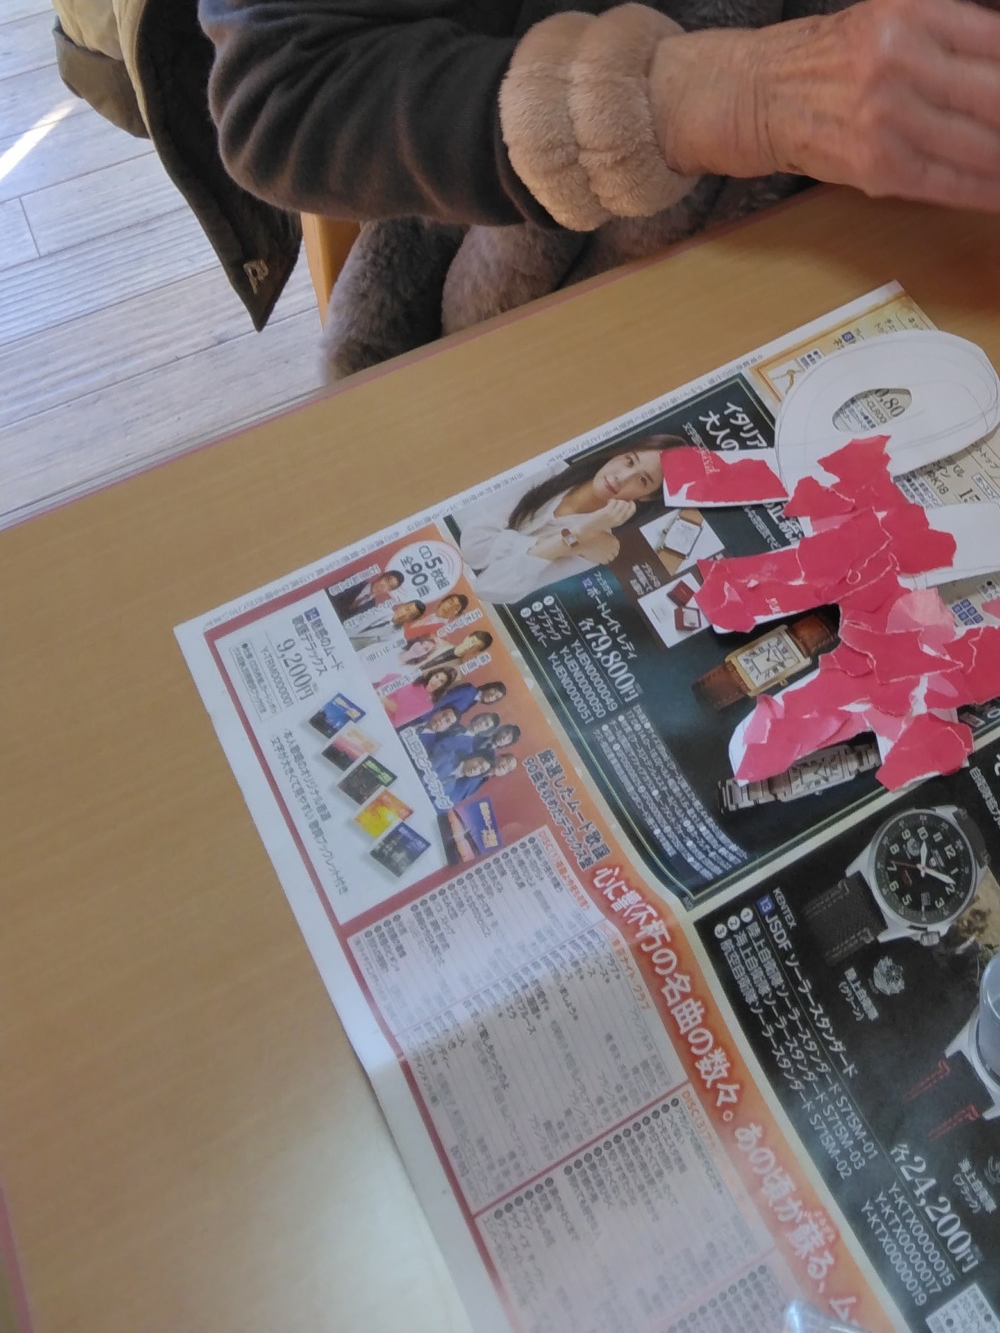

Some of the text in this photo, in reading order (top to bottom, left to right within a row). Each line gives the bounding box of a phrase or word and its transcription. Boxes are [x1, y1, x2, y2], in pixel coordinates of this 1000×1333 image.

[271, 636, 320, 701] 9,200円
[524, 616, 596, 724] シルバー Y-UEN0000051
[536, 609, 608, 719] ブラック Y-UEN0000050
[547, 604, 620, 712] ブラウン Y-UEN0000049
[575, 612, 644, 703] 各79,800円
[584, 584, 622, 635] ポートレイト
[615, 632, 638, 660] レディ
[534, 746, 611, 862] 厳選したムード歌謡
[770, 887, 797, 930] KENTEX
[756, 896, 858, 1080] 13 JSDF ソーラースタンダード
[807, 1112, 852, 1181] S715M-02
[820, 1102, 865, 1172] S715M-03
[834, 1094, 878, 1162] S715M-01
[858, 1199, 928, 1307] Y-KTX0000019
[872, 1191, 942, 1296] Y-KTX0000017
[885, 1182, 956, 1287] Y-KTX0000015
[887, 1140, 980, 1273] 各24,200円
